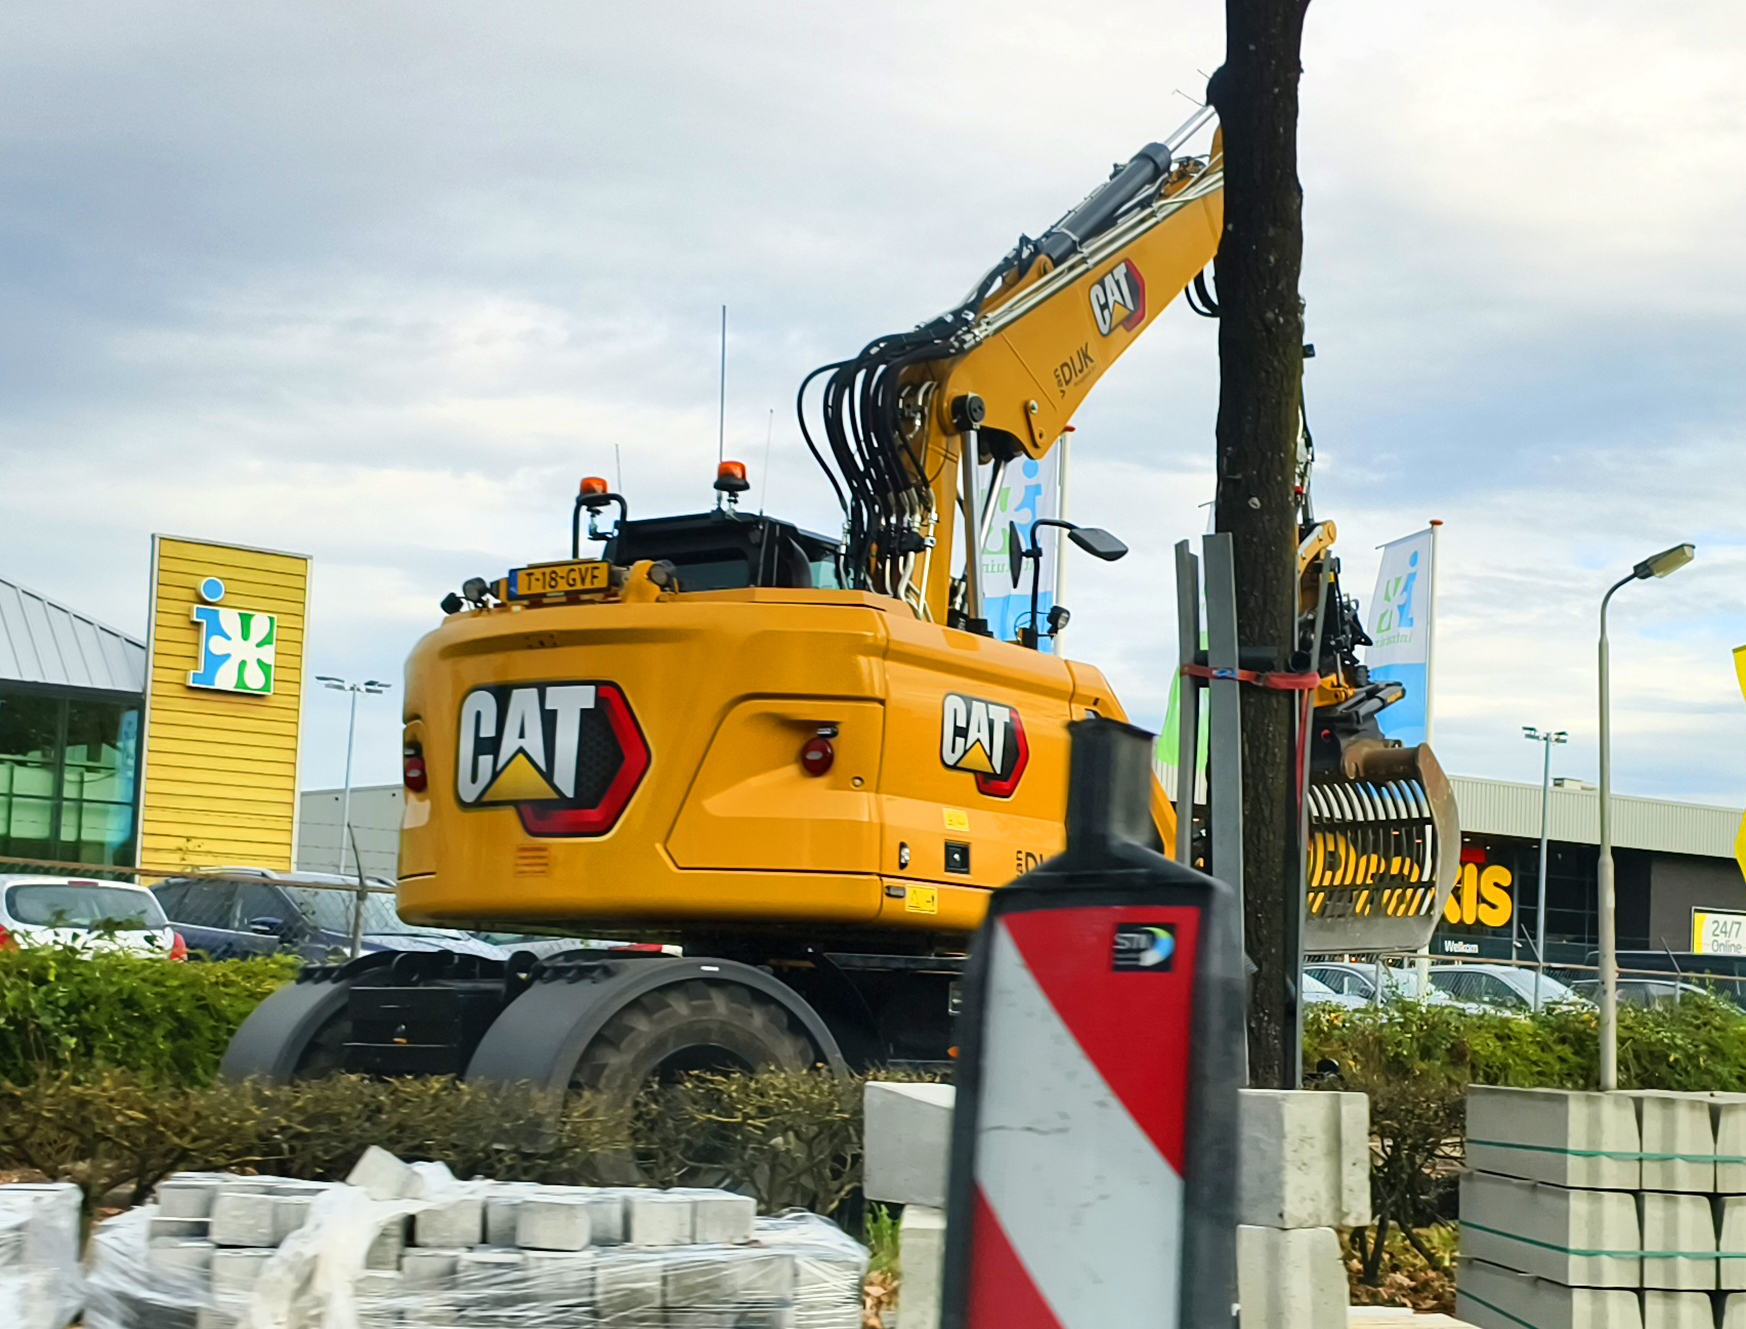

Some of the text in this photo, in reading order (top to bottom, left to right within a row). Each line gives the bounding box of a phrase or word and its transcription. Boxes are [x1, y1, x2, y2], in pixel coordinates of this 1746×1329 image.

[1090, 262, 1134, 335] CAT
[1059, 341, 1094, 386] DIJK
[525, 566, 601, 591] T-18-GVF
[458, 685, 596, 803] CAT
[942, 694, 1010, 775] CAT
[1711, 919, 1742, 939] 24/7
[1711, 939, 1742, 953] Online
